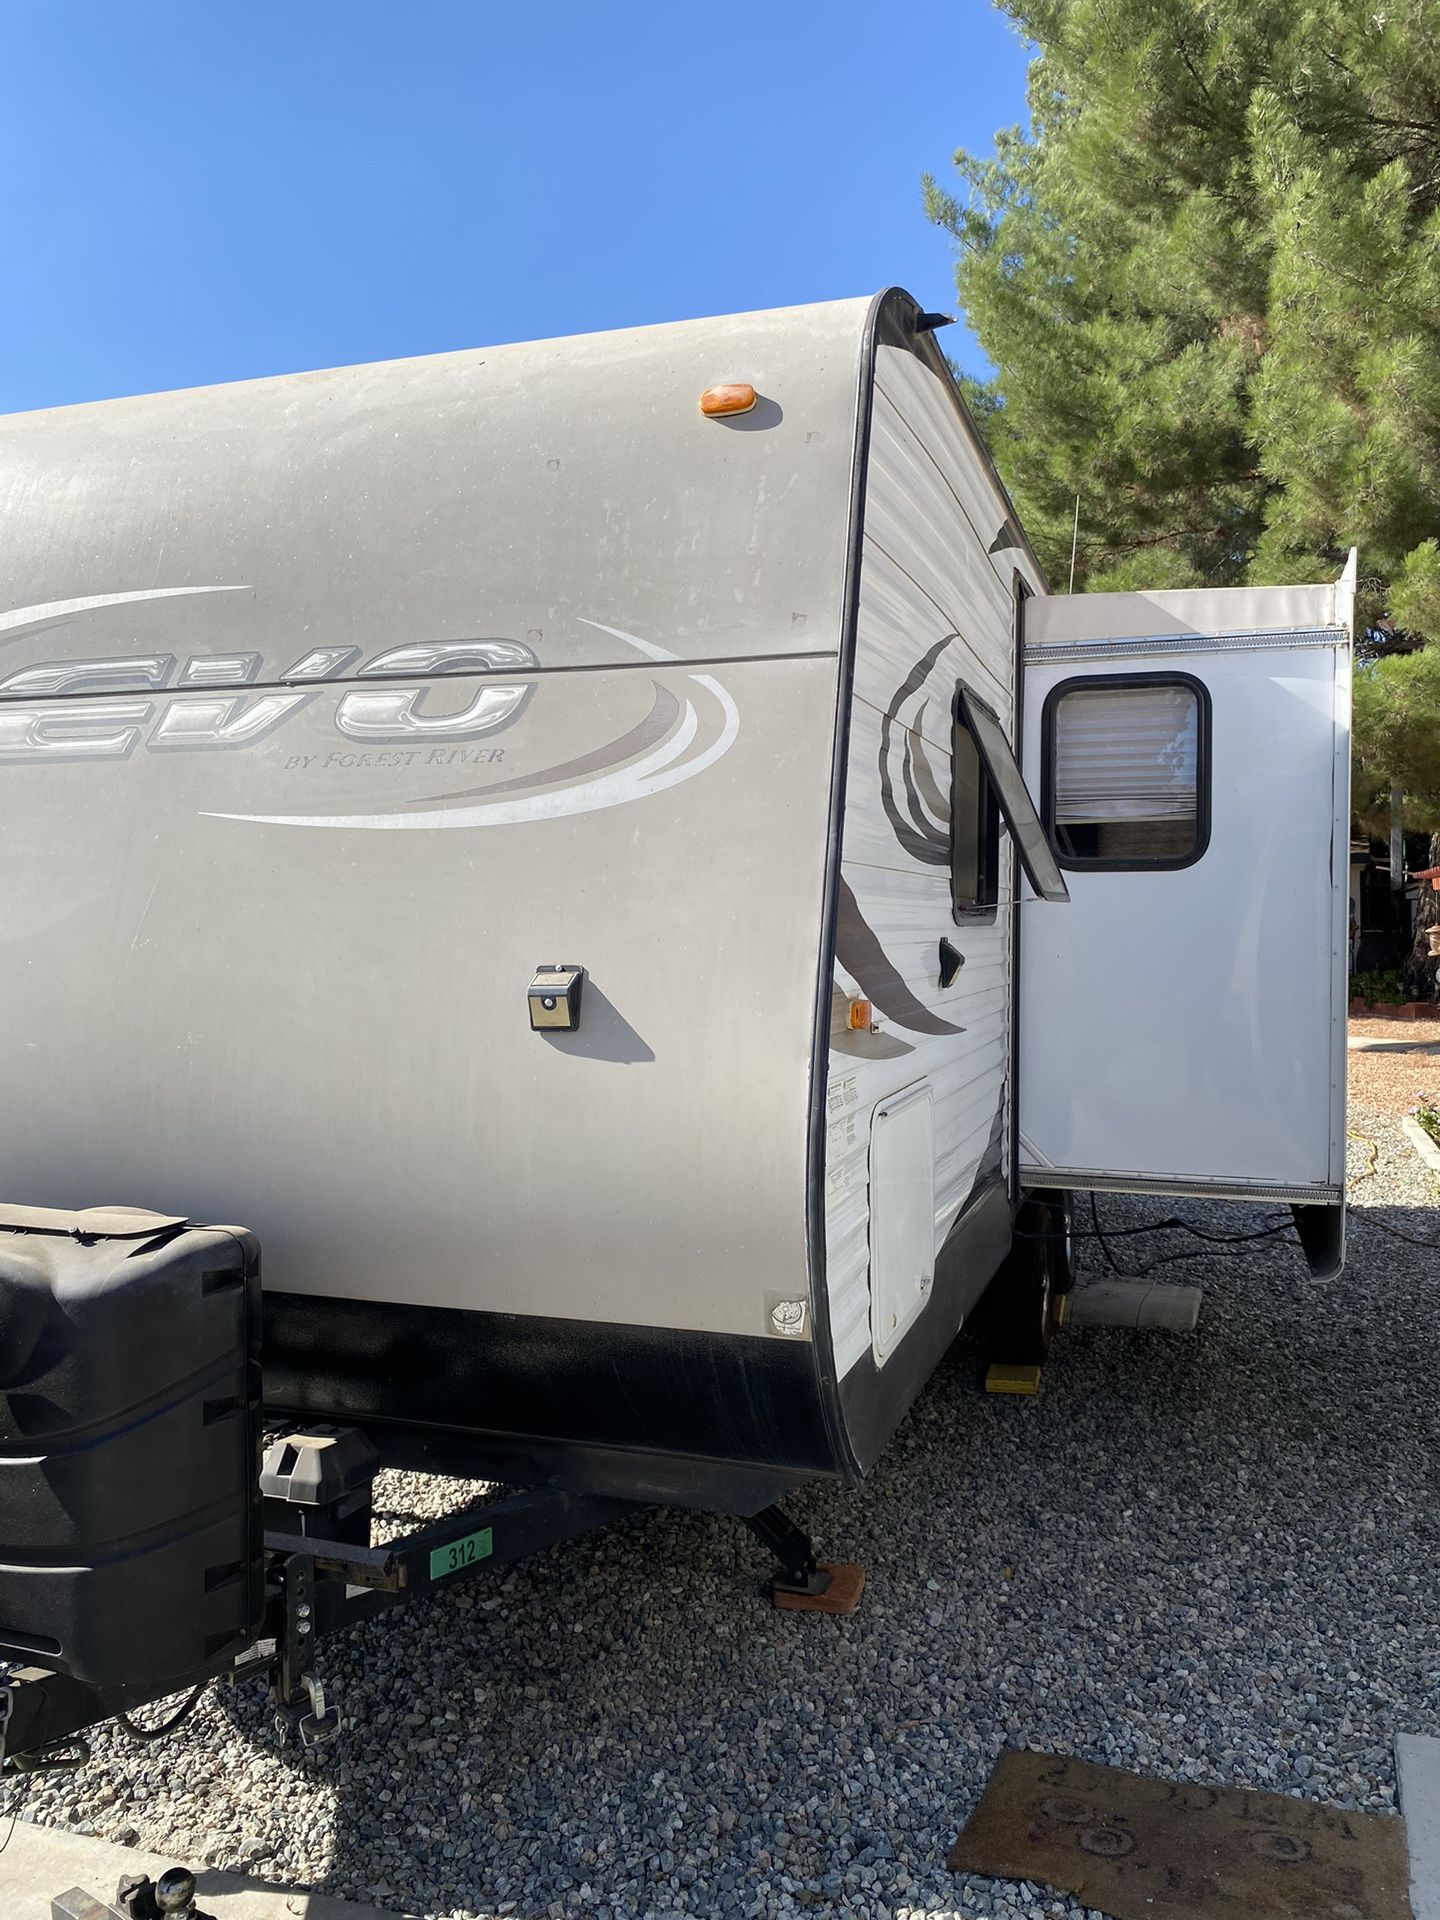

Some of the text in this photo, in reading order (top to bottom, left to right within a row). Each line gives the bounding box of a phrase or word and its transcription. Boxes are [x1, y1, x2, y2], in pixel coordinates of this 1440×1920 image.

[0, 638, 541, 765] EVO
[284, 748, 506, 770] BY FOREST RIVER
[449, 1540, 476, 1570] 312
